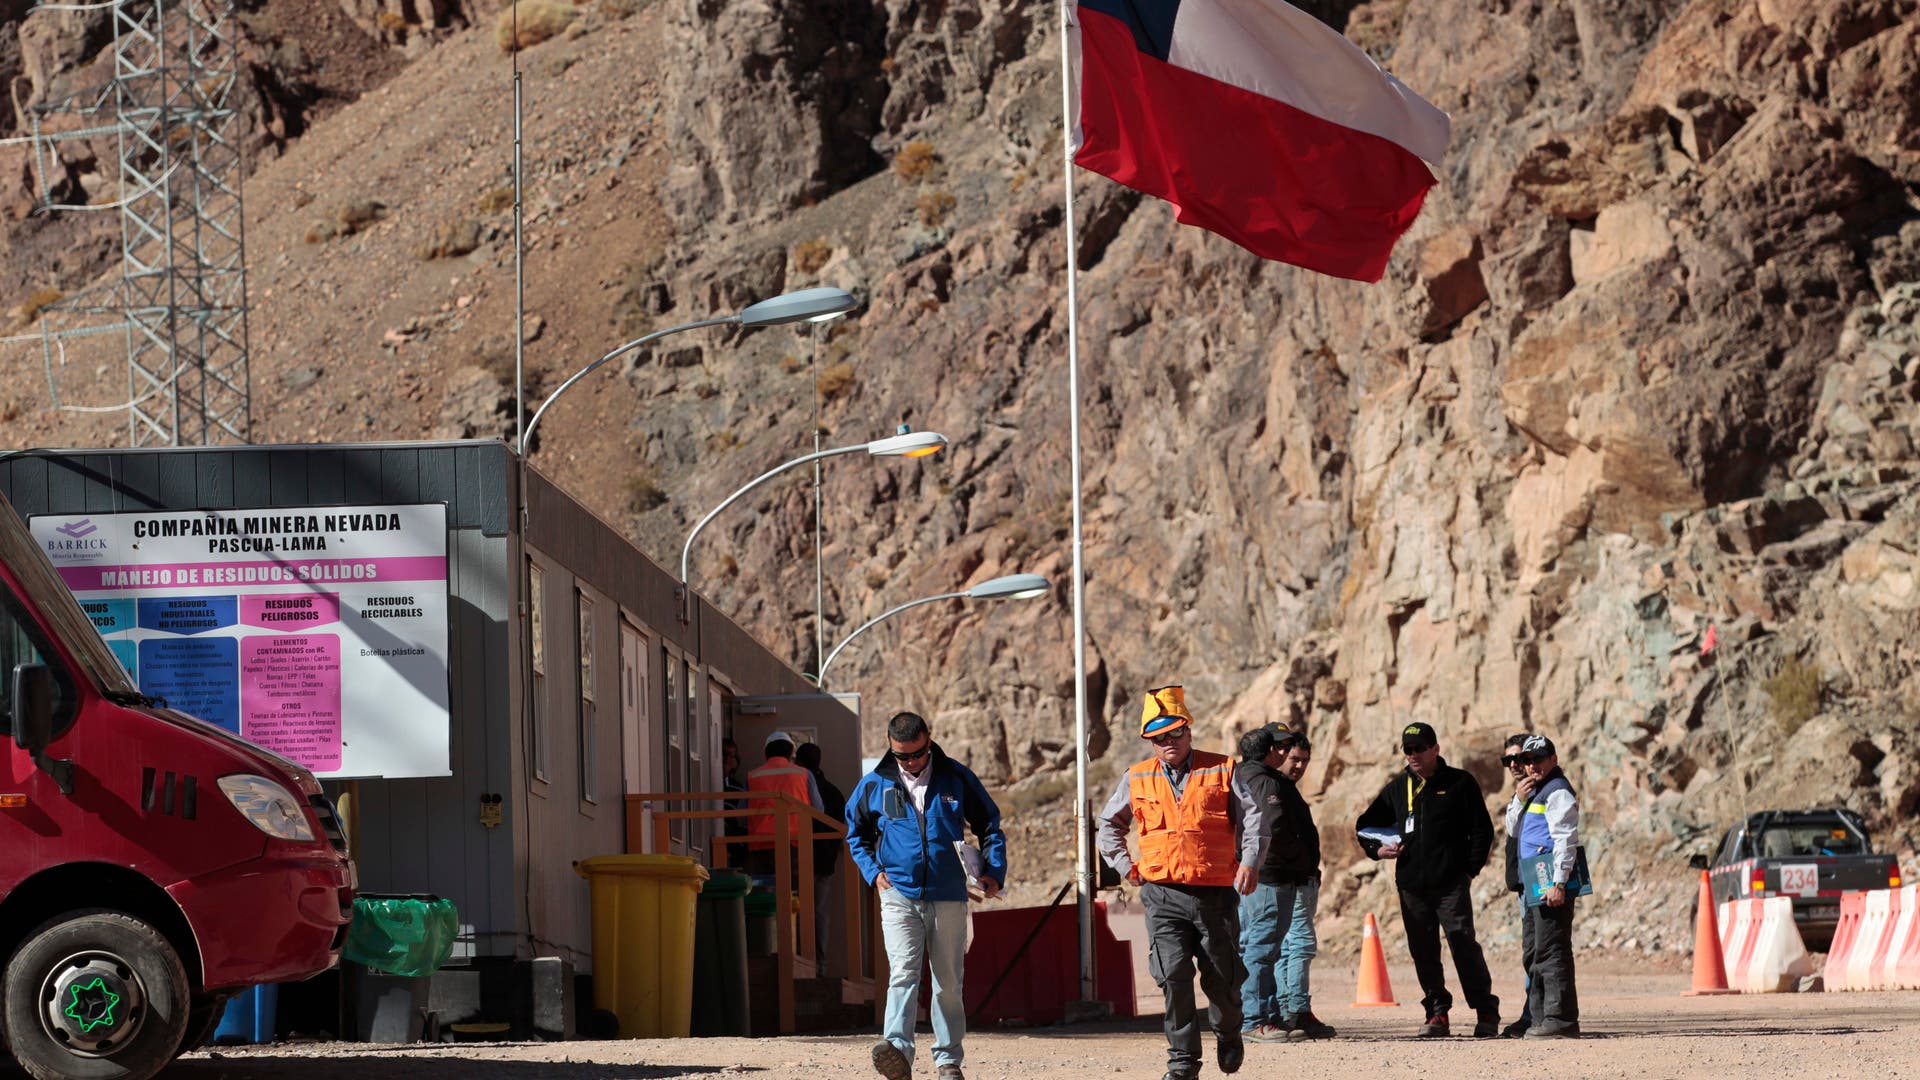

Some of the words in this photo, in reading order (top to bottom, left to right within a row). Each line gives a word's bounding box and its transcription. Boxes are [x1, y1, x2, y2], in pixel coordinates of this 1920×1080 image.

[134, 515, 238, 537] COMPAÑIA
[244, 516, 319, 534] MINERA
[325, 514, 400, 532] NEVADA
[48, 539, 107, 550] BARRICK
[209, 536, 326, 553] PASCUA-LAMA
[102, 569, 171, 586] MANEJO
[176, 569, 198, 584] DE
[203, 566, 294, 583] RESIDUOS
[299, 563, 376, 580] SÓLIDOS
[168, 600, 207, 608] RESIDUOS
[265, 600, 312, 609] RESIDUOS
[367, 596, 414, 606] RESIDUOS
[81, 603, 108, 613] DUOS
[161, 609, 215, 618] INDUSTRIALES
[261, 611, 319, 622] PELIGROSOS
[361, 608, 422, 619] RECICLABLES
[159, 620, 169, 628] NO
[171, 619, 218, 628] PELIGROSOS
[273, 638, 308, 646] ELEMENTOS
[256, 647, 304, 655] CONTAMINADOS
[360, 648, 390, 657] Botellas
[392, 648, 425, 657] plásticas
[1784, 869, 1816, 889] 234
